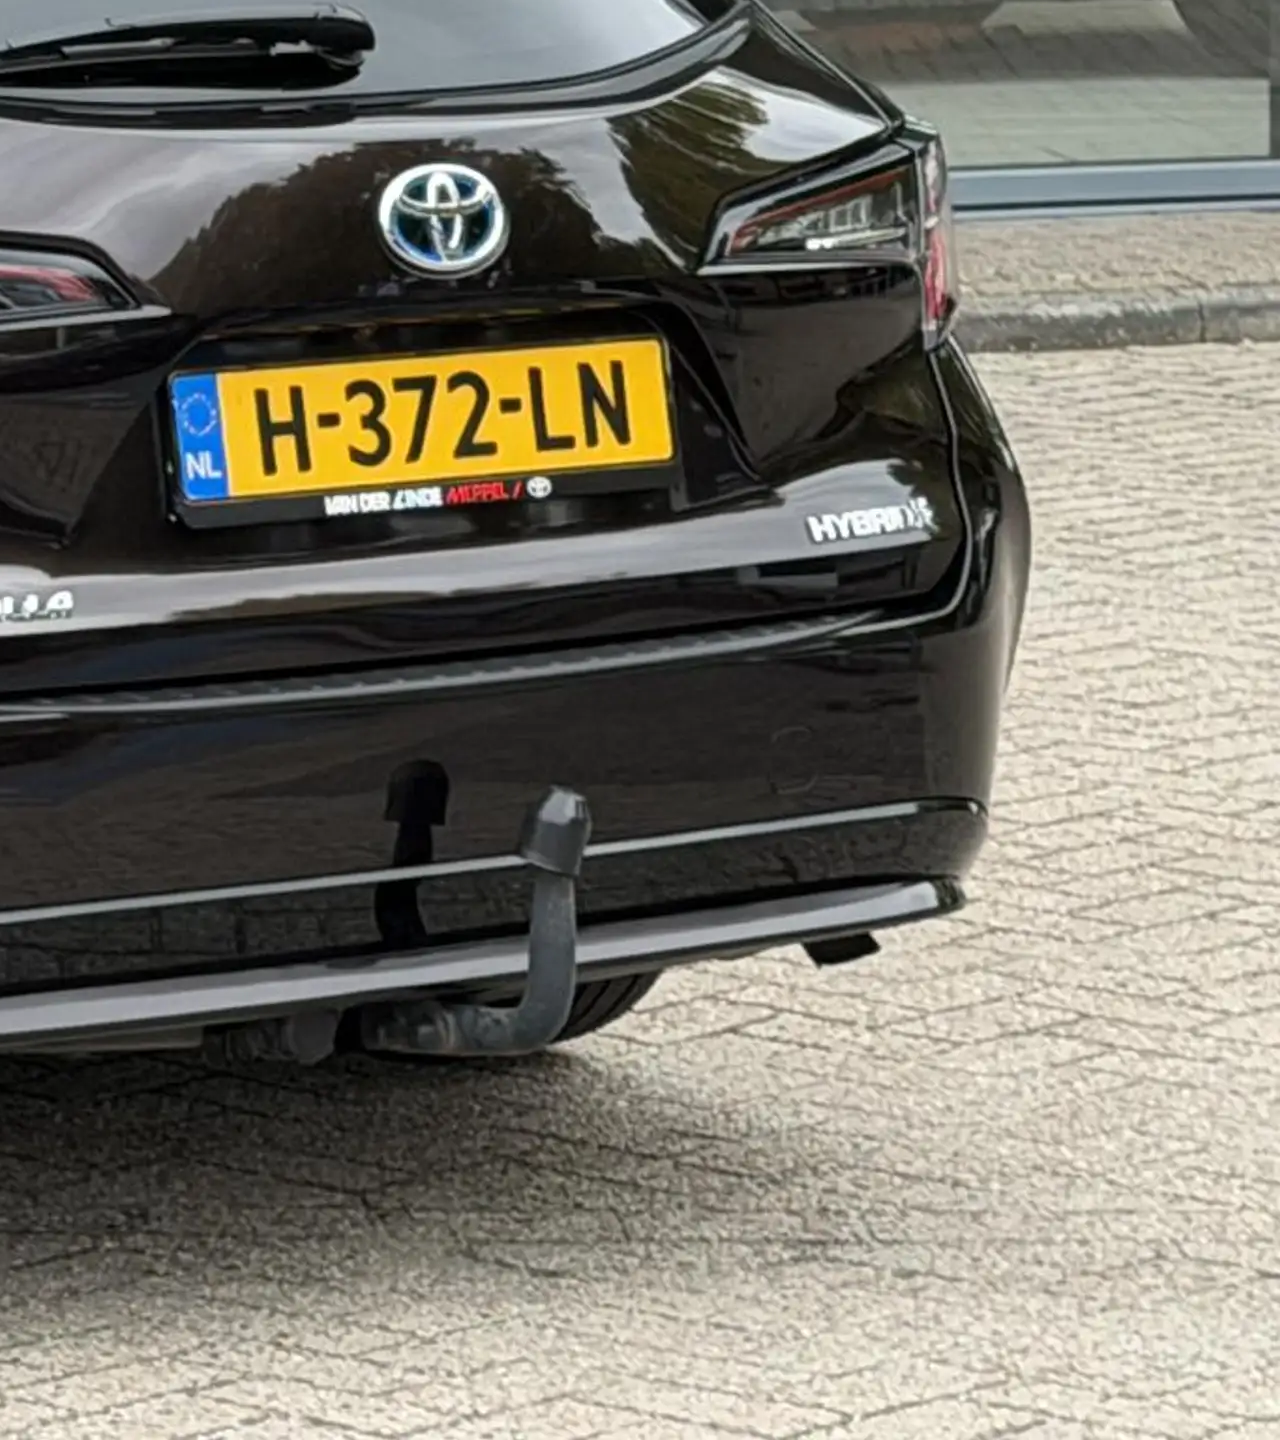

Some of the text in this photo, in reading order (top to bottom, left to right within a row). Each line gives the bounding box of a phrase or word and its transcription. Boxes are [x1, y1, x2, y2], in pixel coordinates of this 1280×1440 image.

[253, 360, 631, 477] H-372-LN
[186, 452, 222, 480] NL
[324, 496, 359, 516] VAN
[360, 491, 391, 513] DER
